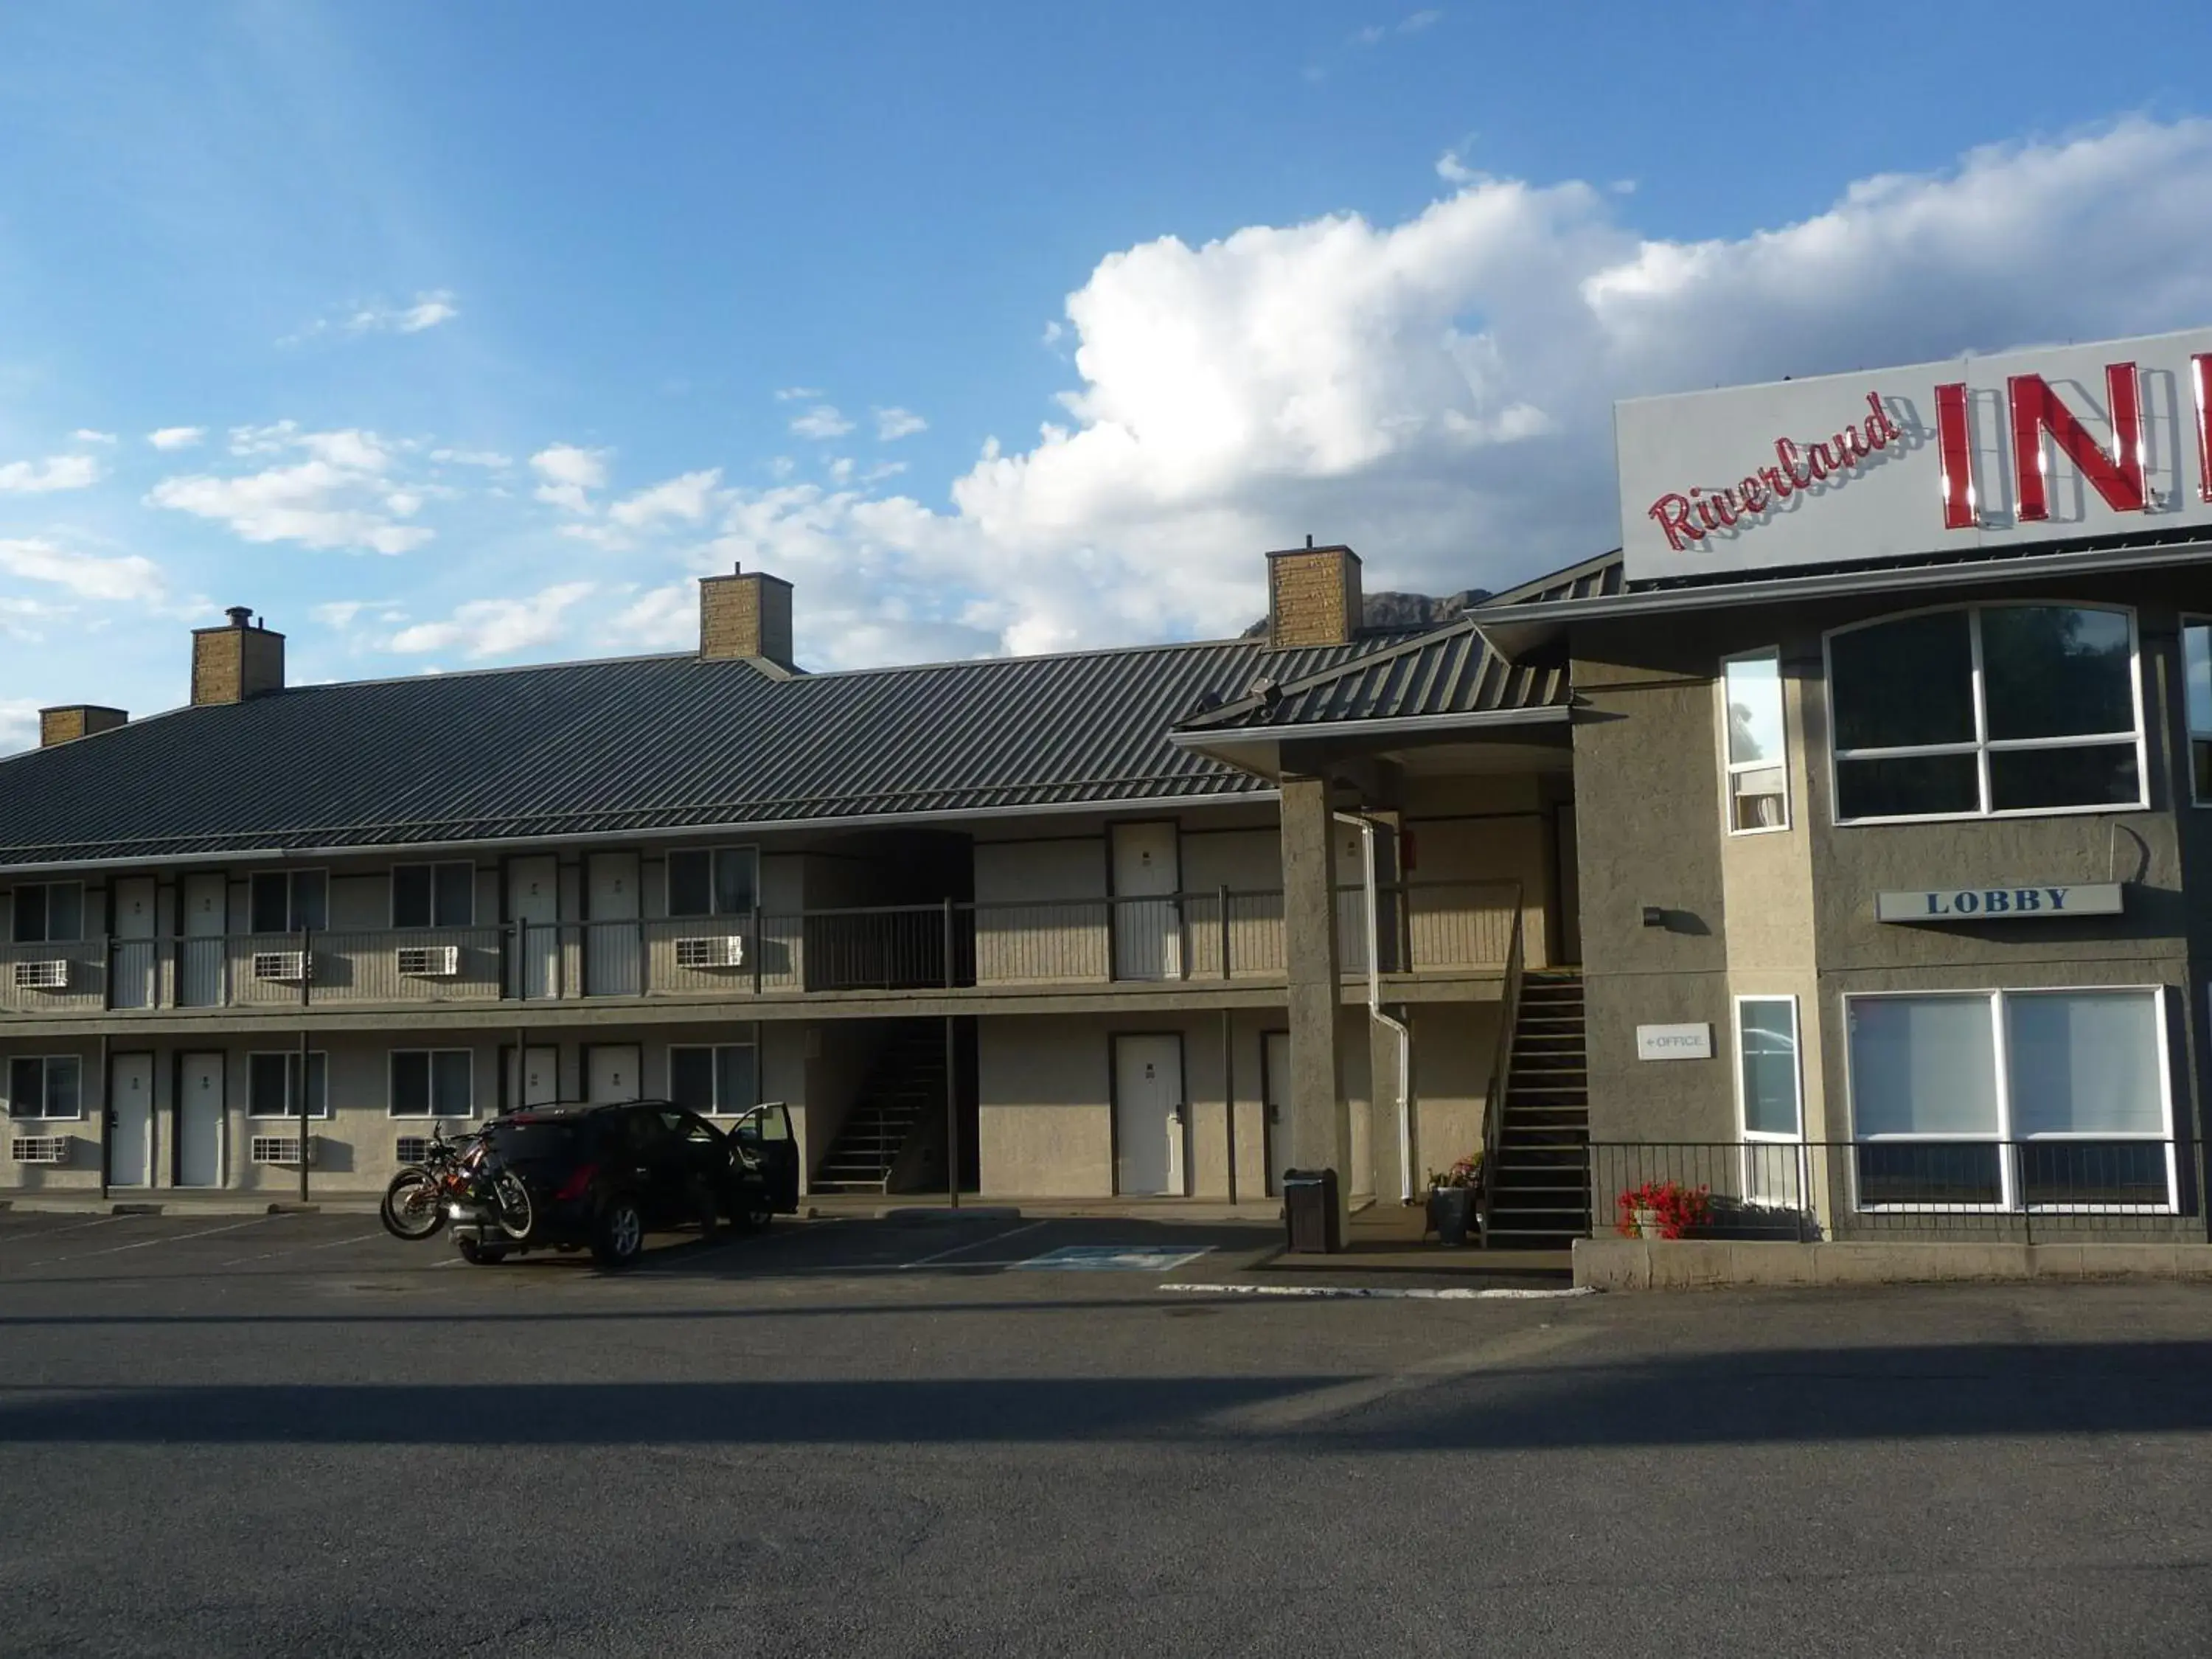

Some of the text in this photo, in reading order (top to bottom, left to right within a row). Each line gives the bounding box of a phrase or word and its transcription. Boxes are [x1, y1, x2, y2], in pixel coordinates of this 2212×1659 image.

[1648, 352, 2212, 551] Riverland IN
[1925, 888, 2070, 915] LOBBY
[1657, 1035, 1705, 1047] OFFICE
